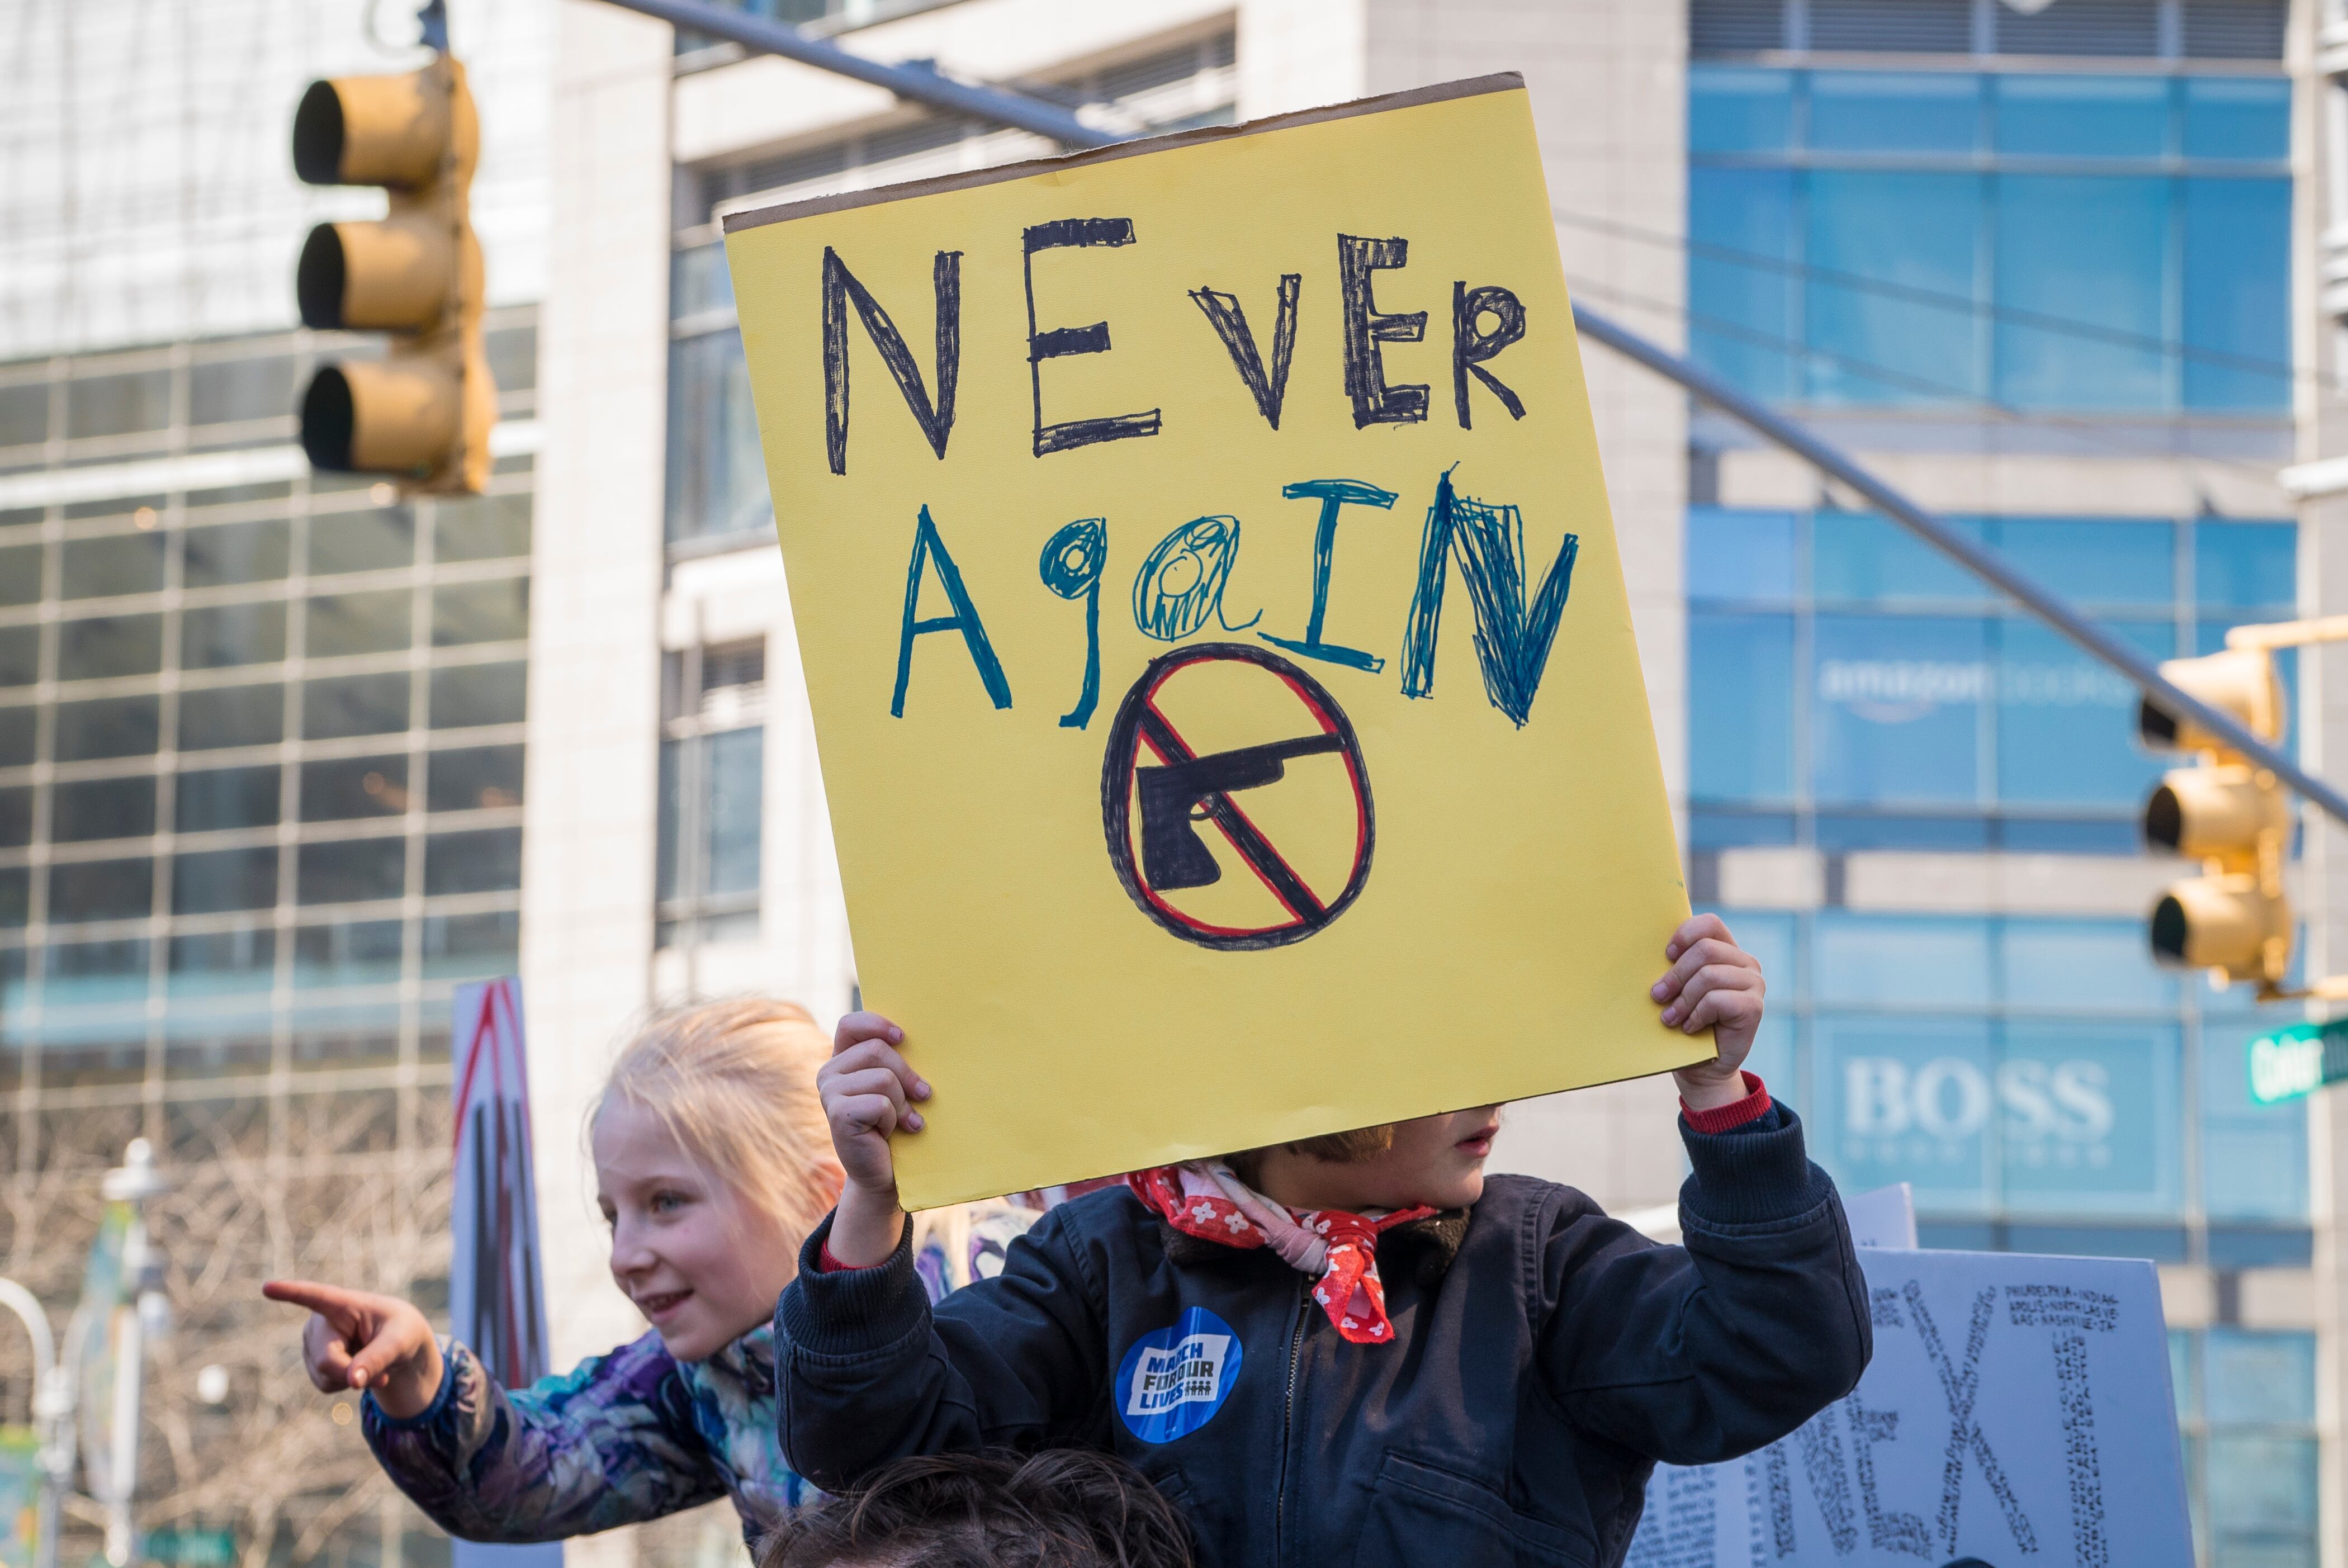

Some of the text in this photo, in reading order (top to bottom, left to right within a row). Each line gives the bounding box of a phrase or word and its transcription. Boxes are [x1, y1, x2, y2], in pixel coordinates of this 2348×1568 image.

[823, 217, 1527, 475] NEVER
[1846, 1056, 2117, 1144] BOSS
[1146, 1342, 1203, 1373] MARCH
[1139, 1382, 1184, 1409] LIVES
